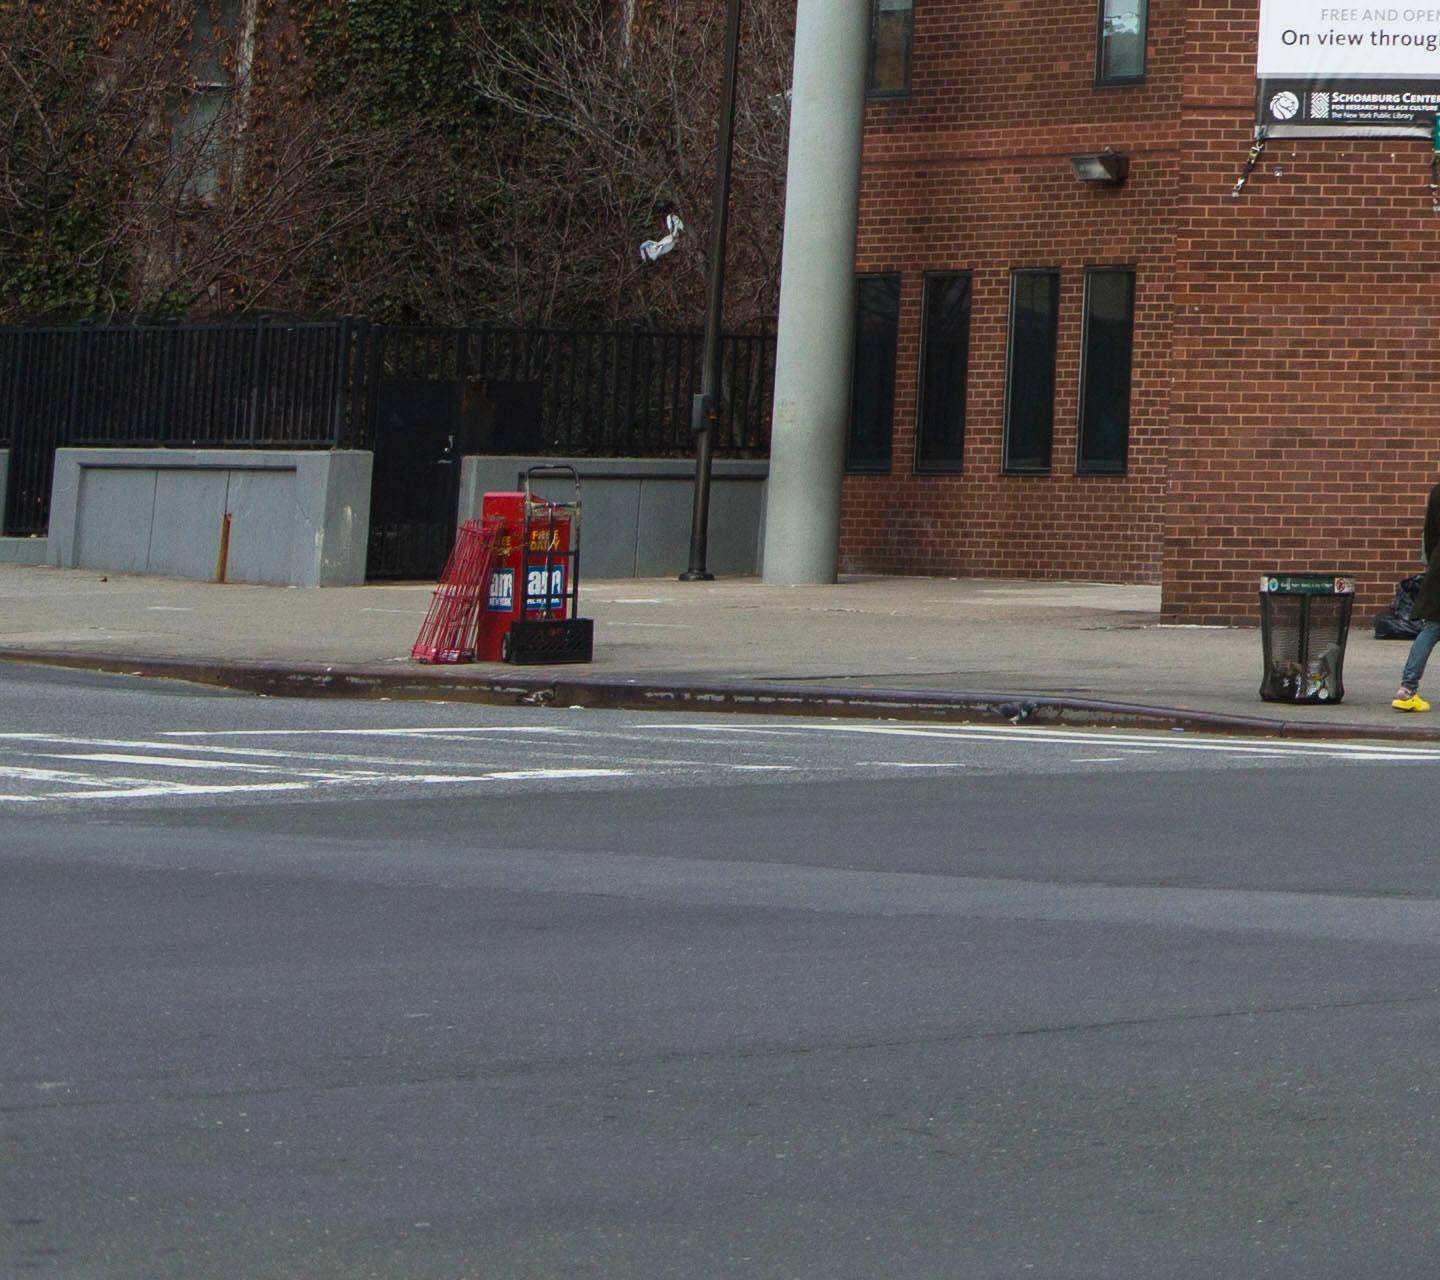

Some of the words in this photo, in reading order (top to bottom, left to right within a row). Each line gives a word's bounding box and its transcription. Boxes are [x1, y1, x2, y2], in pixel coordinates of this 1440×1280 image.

[1321, 7, 1358, 21] FREE
[1362, 8, 1398, 22] AND
[1281, 29, 1309, 47] On
[1317, 29, 1364, 47] view
[1331, 91, 1400, 102] SCHOMBURG
[529, 540, 560, 551] DAIY
